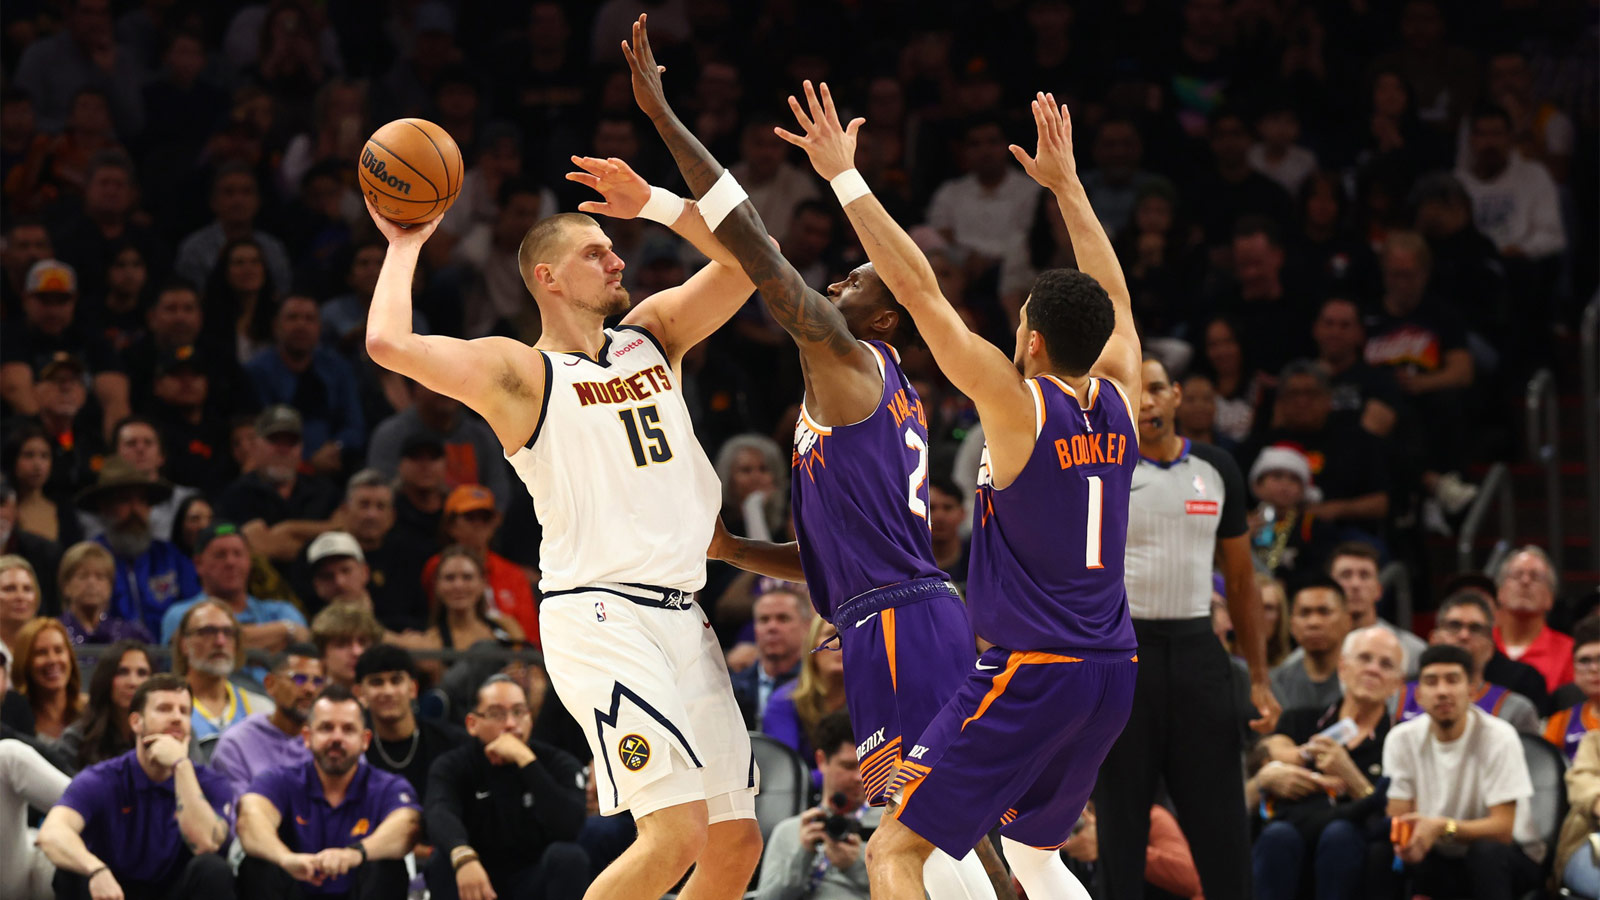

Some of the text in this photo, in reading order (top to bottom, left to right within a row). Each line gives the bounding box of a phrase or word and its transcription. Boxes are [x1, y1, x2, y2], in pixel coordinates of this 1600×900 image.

[361, 146, 412, 195] Wilson
[613, 338, 644, 358] ibotta
[618, 404, 674, 468] 15
[1054, 433, 1127, 470] BOOKER
[1085, 475, 1105, 569] 1
